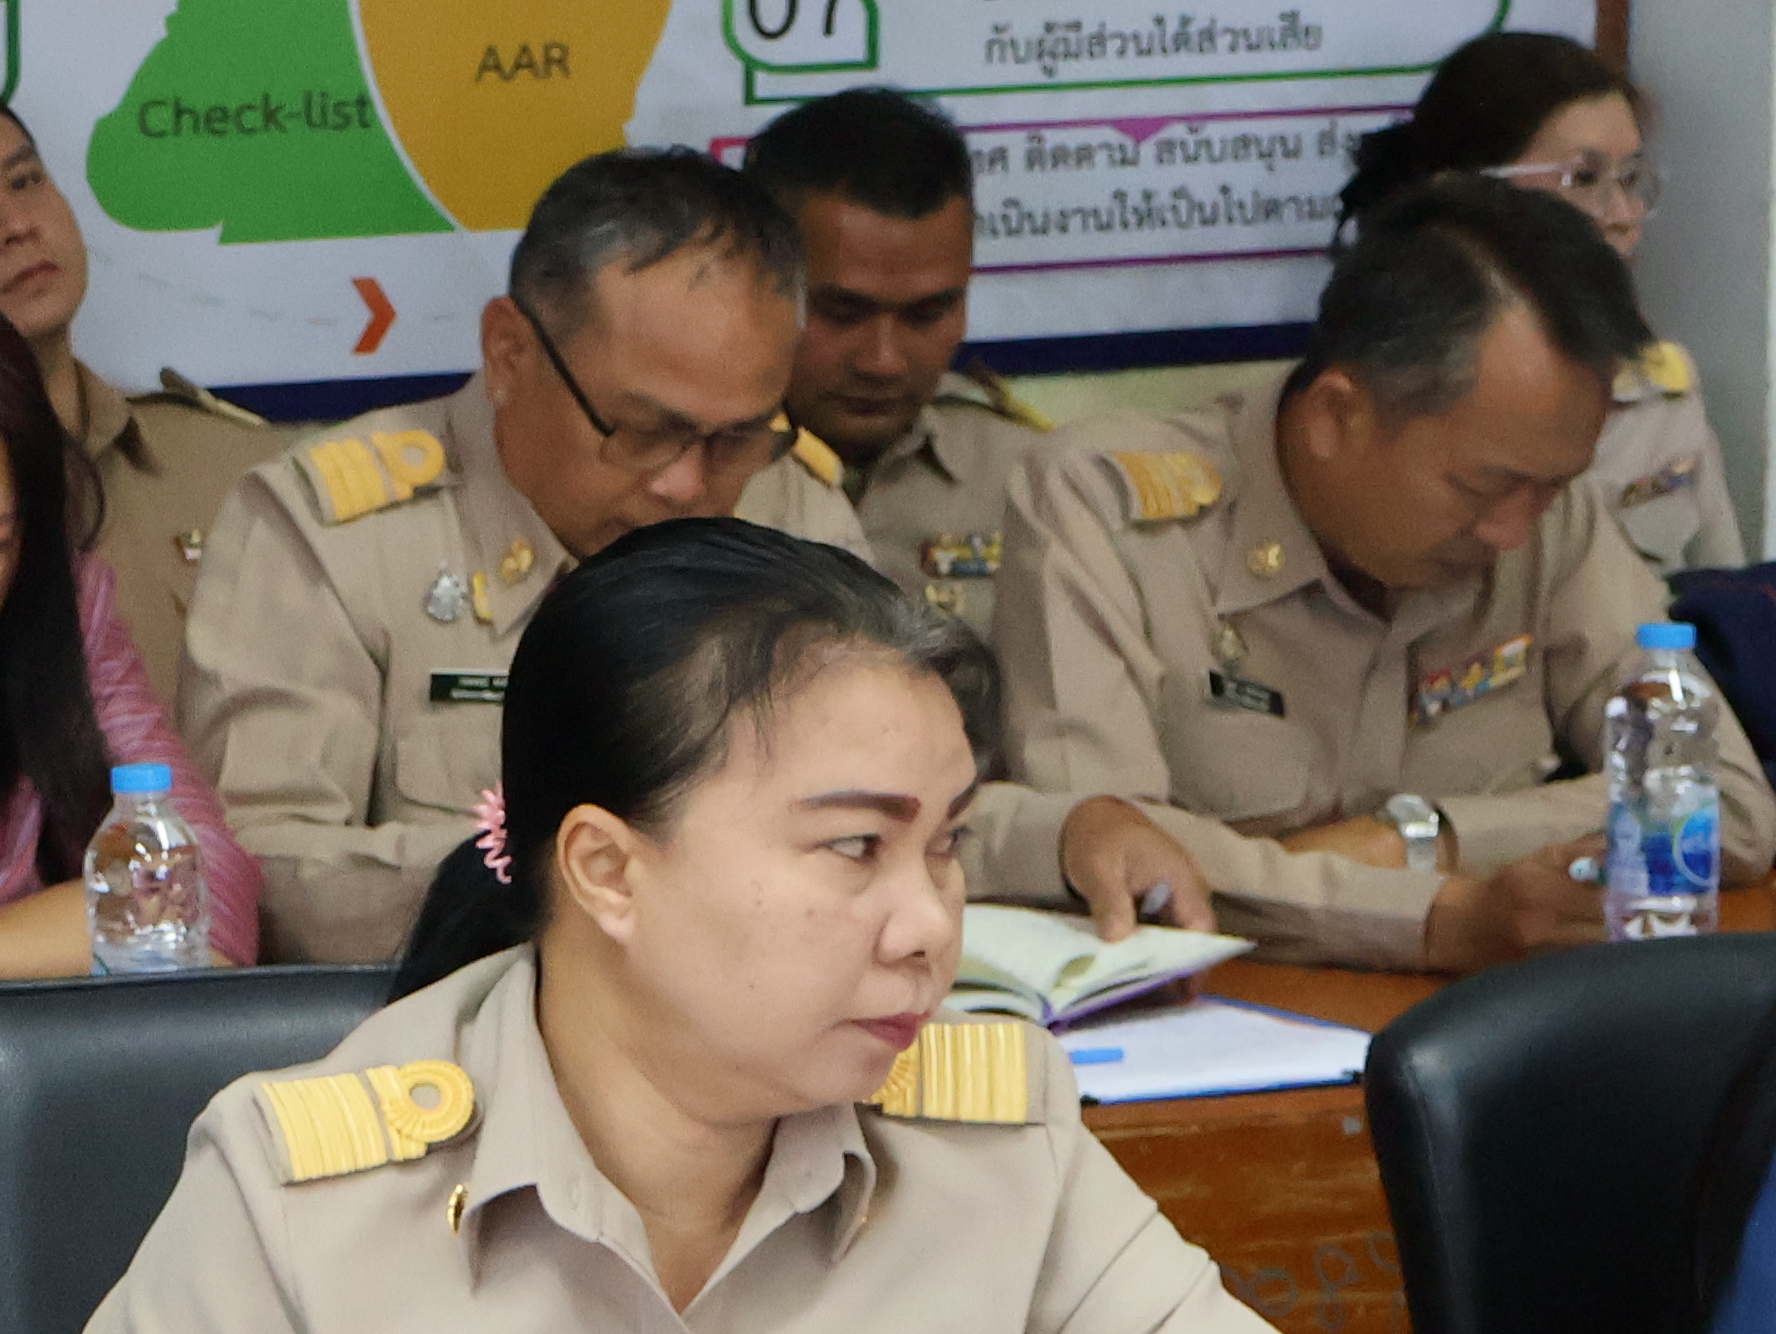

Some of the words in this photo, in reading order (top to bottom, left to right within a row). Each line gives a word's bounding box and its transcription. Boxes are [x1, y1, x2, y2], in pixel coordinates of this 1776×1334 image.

[473, 40, 572, 86] AAR
[137, 92, 374, 140] Check-list
[1024, 130, 1140, 172] ติดตาม
[1155, 121, 1302, 172] สนับสนุน
